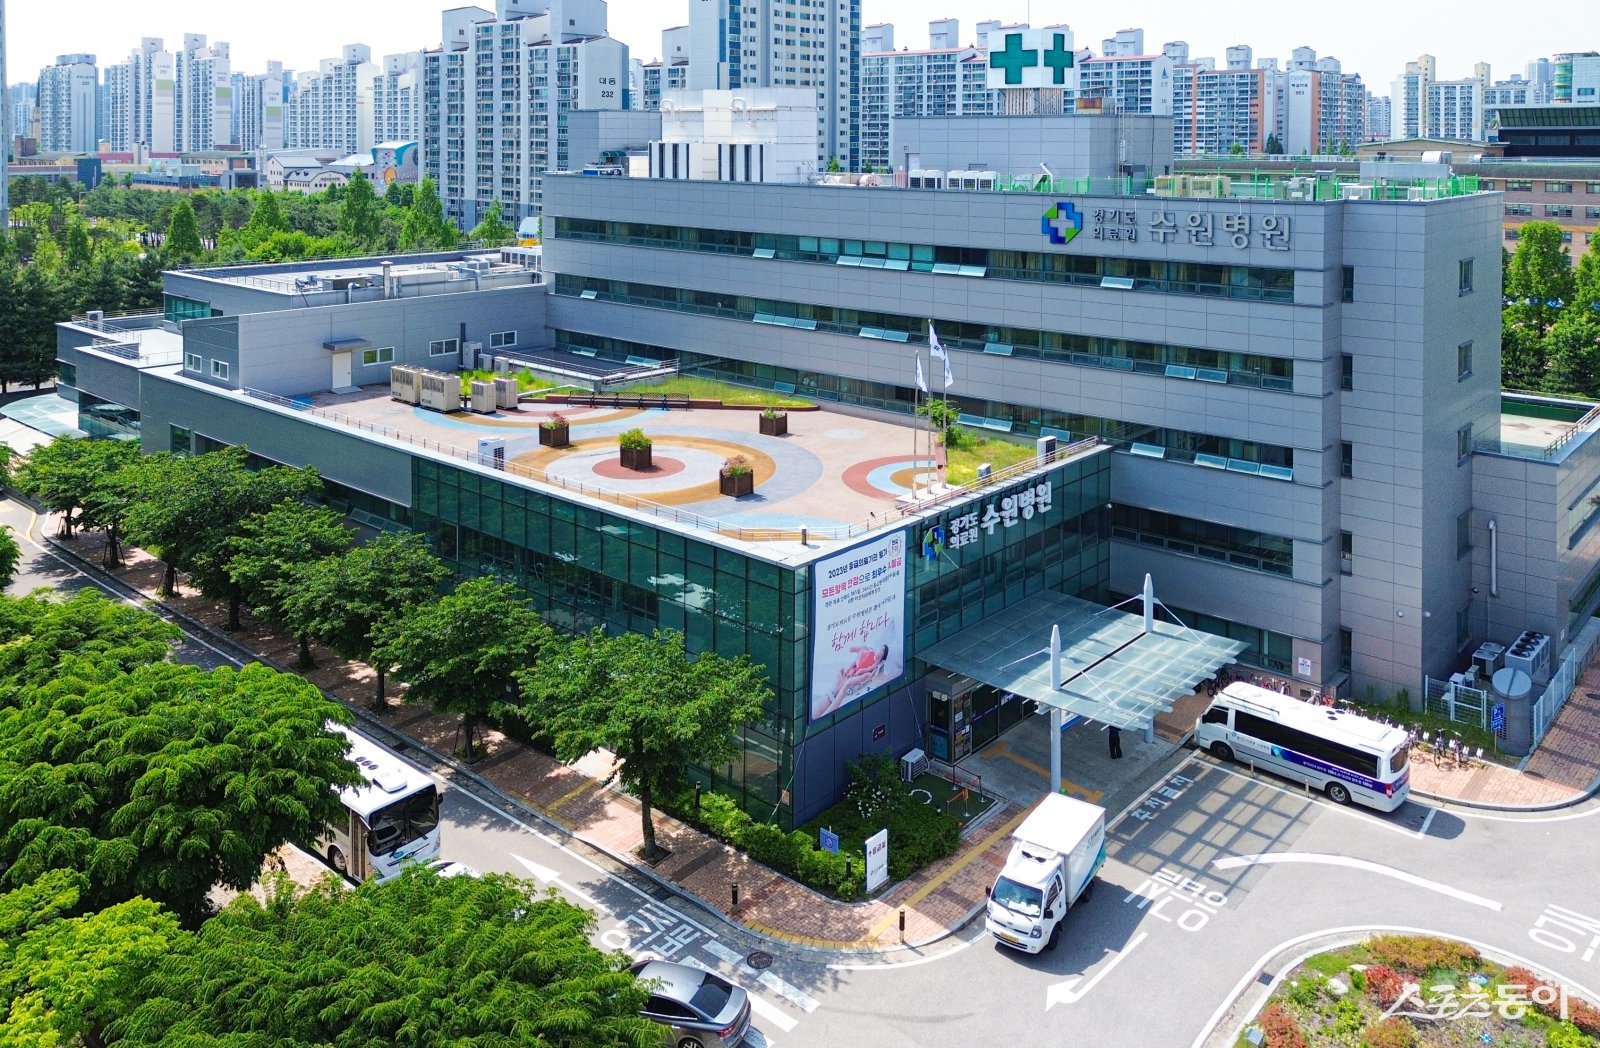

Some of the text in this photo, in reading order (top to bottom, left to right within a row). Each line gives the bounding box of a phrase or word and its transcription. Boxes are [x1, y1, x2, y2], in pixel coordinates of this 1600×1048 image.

[601, 90, 614, 98] 232
[1093, 208, 1137, 225] 경기도
[1093, 226, 1137, 243] 의료원
[1148, 210, 1291, 251] 수원병원
[981, 481, 1052, 535] 수원병원
[950, 512, 979, 534] 경기도
[949, 527, 979, 549] 의료원
[828, 564, 848, 579] 2023년
[831, 611, 890, 652] 함께 합니다
[1131, 775, 1194, 821] 주차금지
[1123, 867, 1228, 932] 응급실
